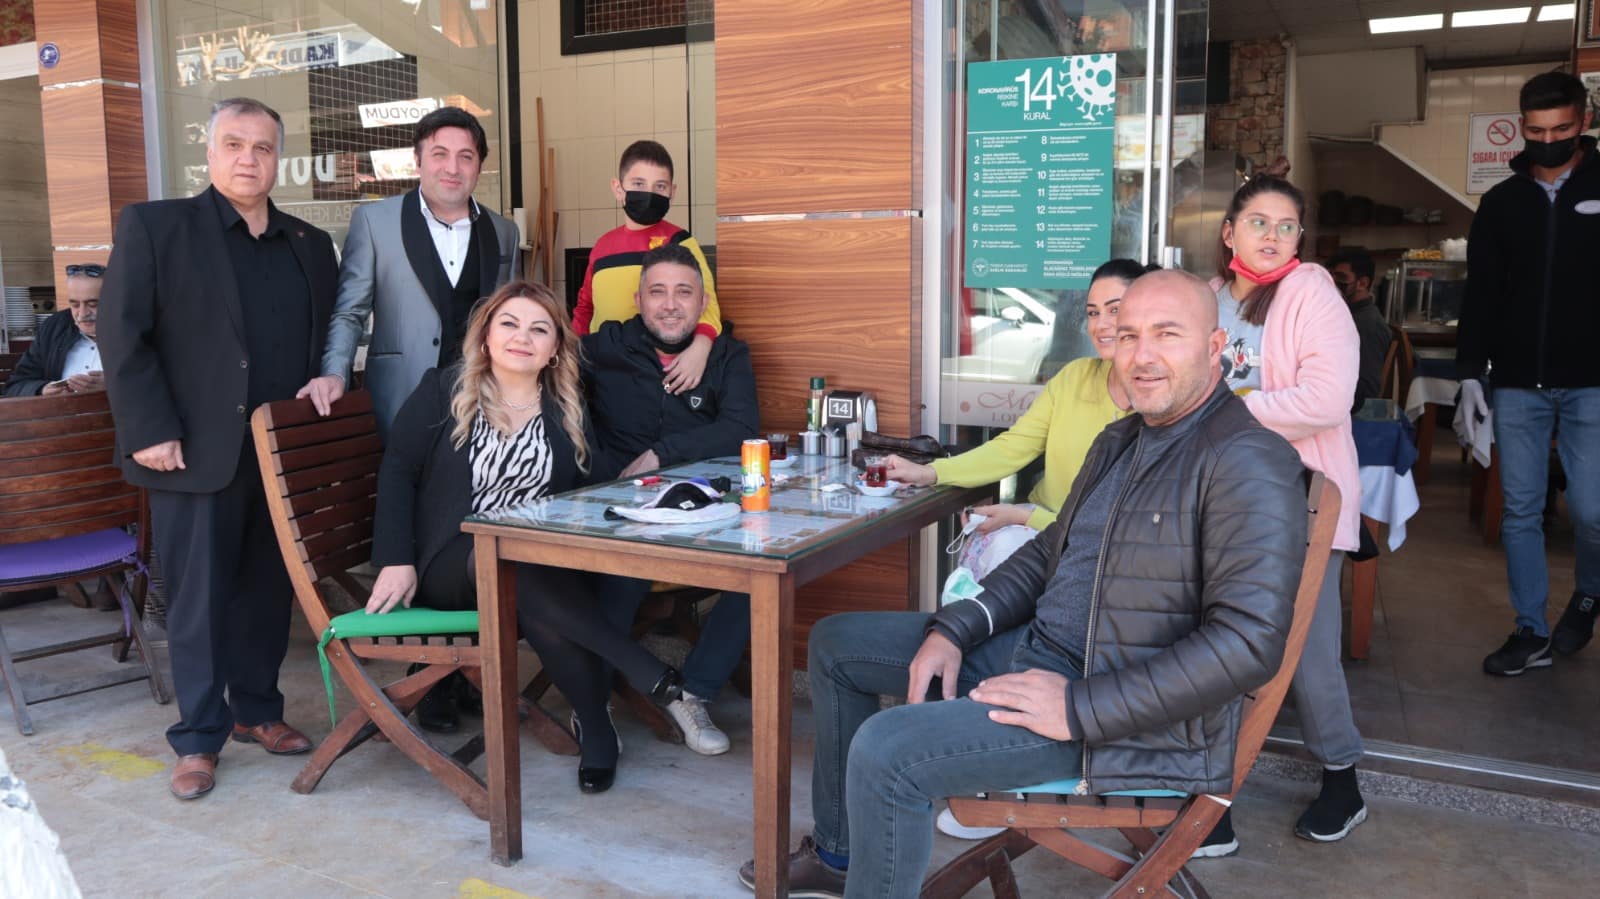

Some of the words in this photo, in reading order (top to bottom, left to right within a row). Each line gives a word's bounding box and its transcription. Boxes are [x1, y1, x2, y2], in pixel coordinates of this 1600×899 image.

[1015, 67, 1057, 111] 14
[1023, 112, 1051, 120] KURAL
[975, 139, 979, 147] 1
[1041, 136, 1047, 144] 8
[974, 156, 980, 164] 2
[1041, 153, 1047, 162] 9
[974, 172, 979, 181] 3
[1038, 171, 1046, 179] 10
[973, 189, 979, 197] 4
[1038, 188, 1045, 196] 11
[973, 206, 979, 215] 5
[1037, 205, 1045, 214] 12
[972, 222, 979, 231] 6
[1036, 222, 1045, 231] 13
[972, 240, 978, 248] 7
[1035, 240, 1045, 248] 14
[833, 403, 848, 414] 14
